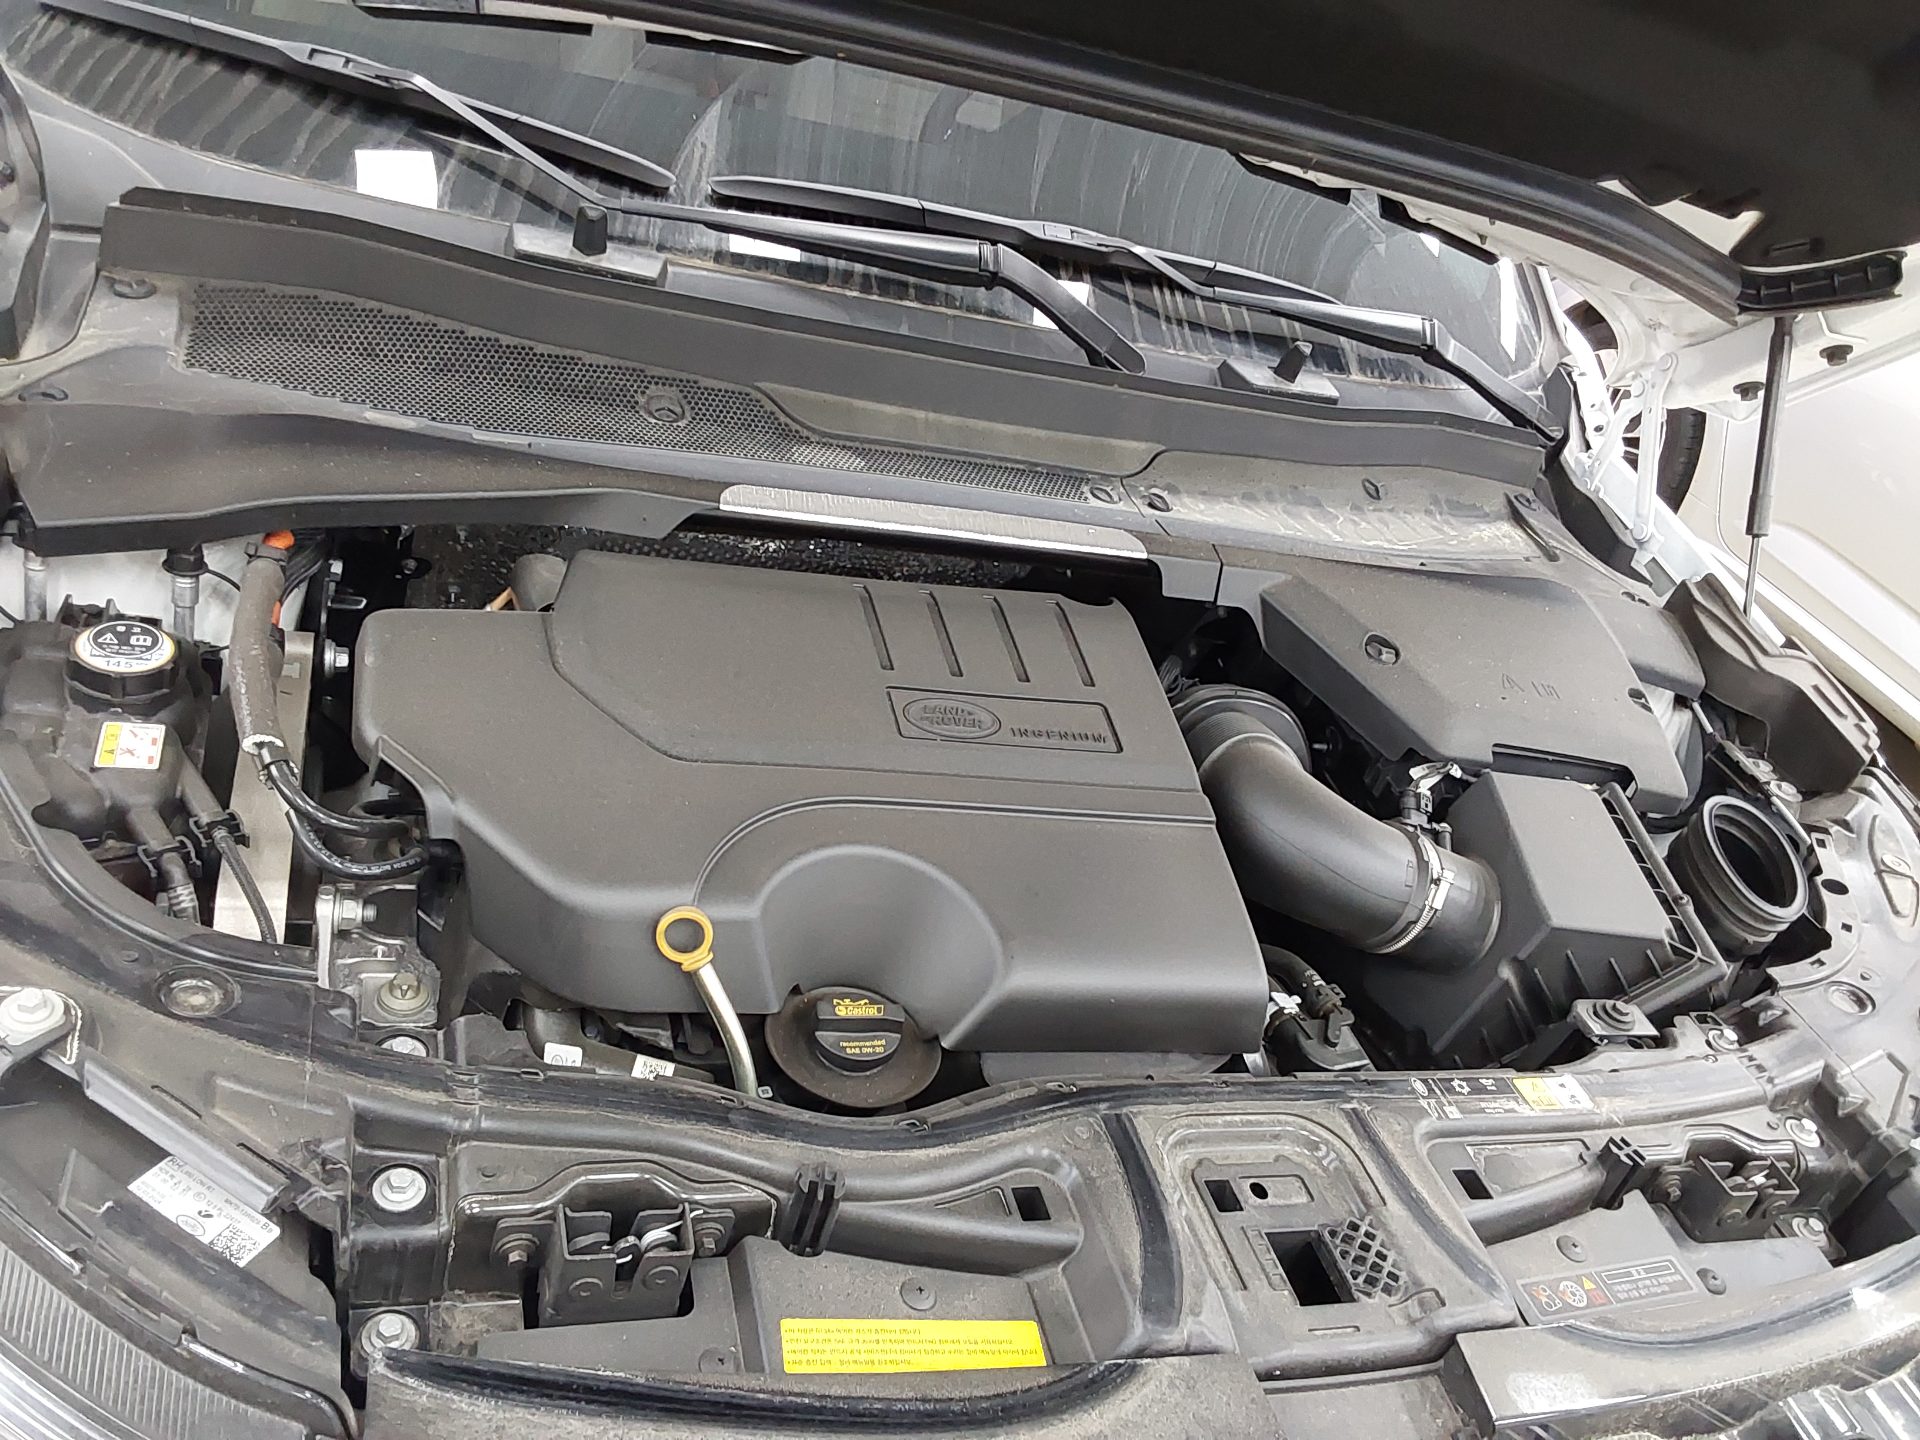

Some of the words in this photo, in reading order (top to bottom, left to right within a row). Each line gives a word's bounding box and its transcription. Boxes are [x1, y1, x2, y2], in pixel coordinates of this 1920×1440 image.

[104, 660, 133, 669] 145
[927, 715, 983, 730] ROVER
[1010, 727, 1108, 744] INGENIUM
[839, 1038, 886, 1047] recommended
[845, 1047, 861, 1055] SAE
